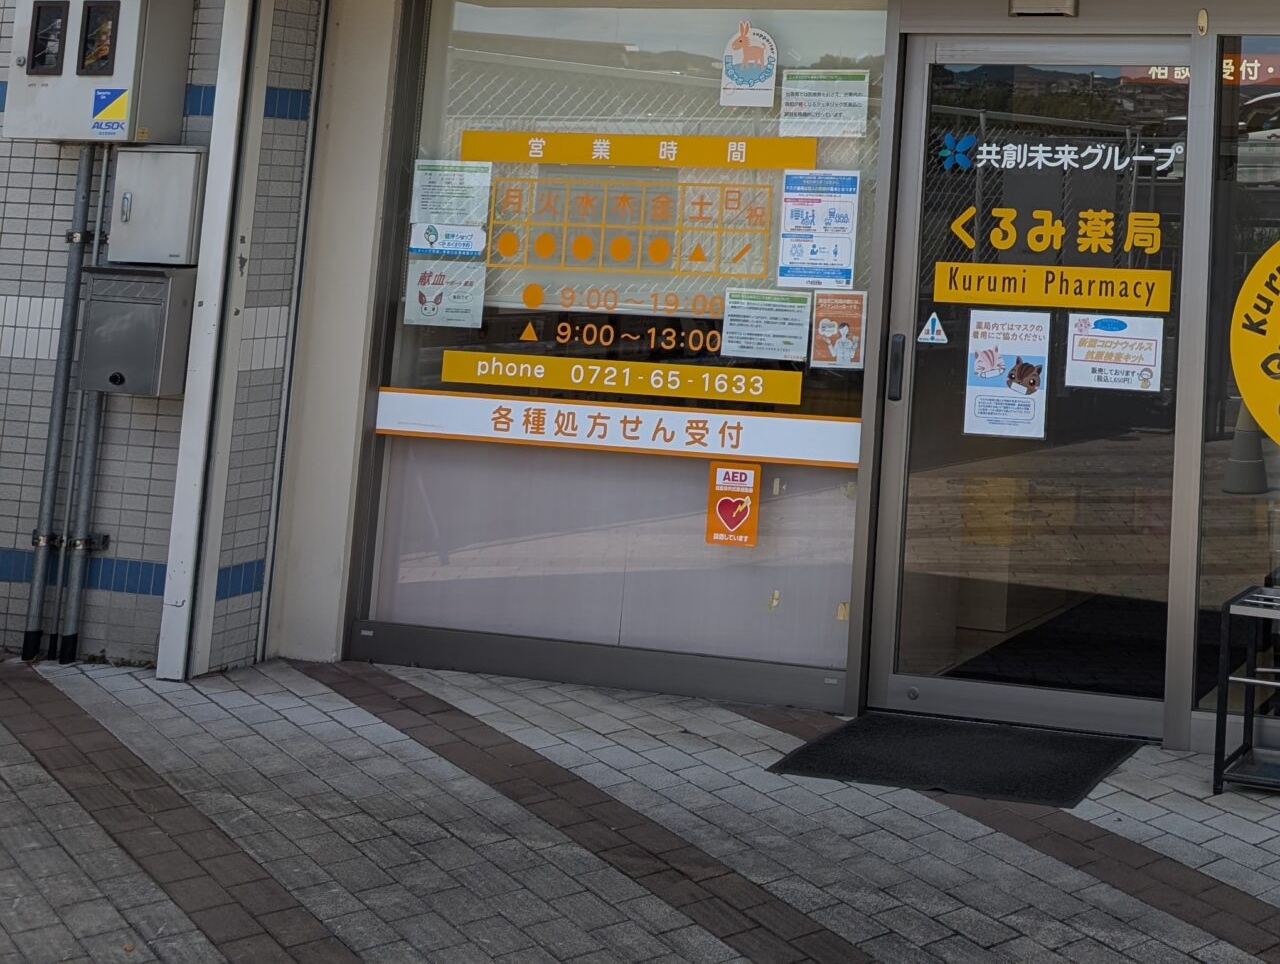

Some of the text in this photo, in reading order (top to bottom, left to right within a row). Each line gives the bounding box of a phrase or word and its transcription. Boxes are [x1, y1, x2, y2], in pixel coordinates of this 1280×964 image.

[91, 122, 125, 131] ALSOK
[528, 138, 746, 163] 営業時間
[976, 142, 1184, 171] 共創未来グループ
[503, 188, 523, 215] 月
[538, 190, 560, 217] 火
[575, 190, 597, 217] 水
[613, 192, 635, 218] 木
[651, 194, 674, 220] 金
[689, 198, 712, 221] 土
[949, 206, 1161, 254] くるみ薬局
[948, 267, 1156, 306] Kurumi Pharmacy
[975, 321, 1043, 332] 薬局内ではマスクの
[477, 357, 545, 380] phone
[491, 405, 744, 449] 各種処方せん受付
[723, 471, 748, 482] AED
